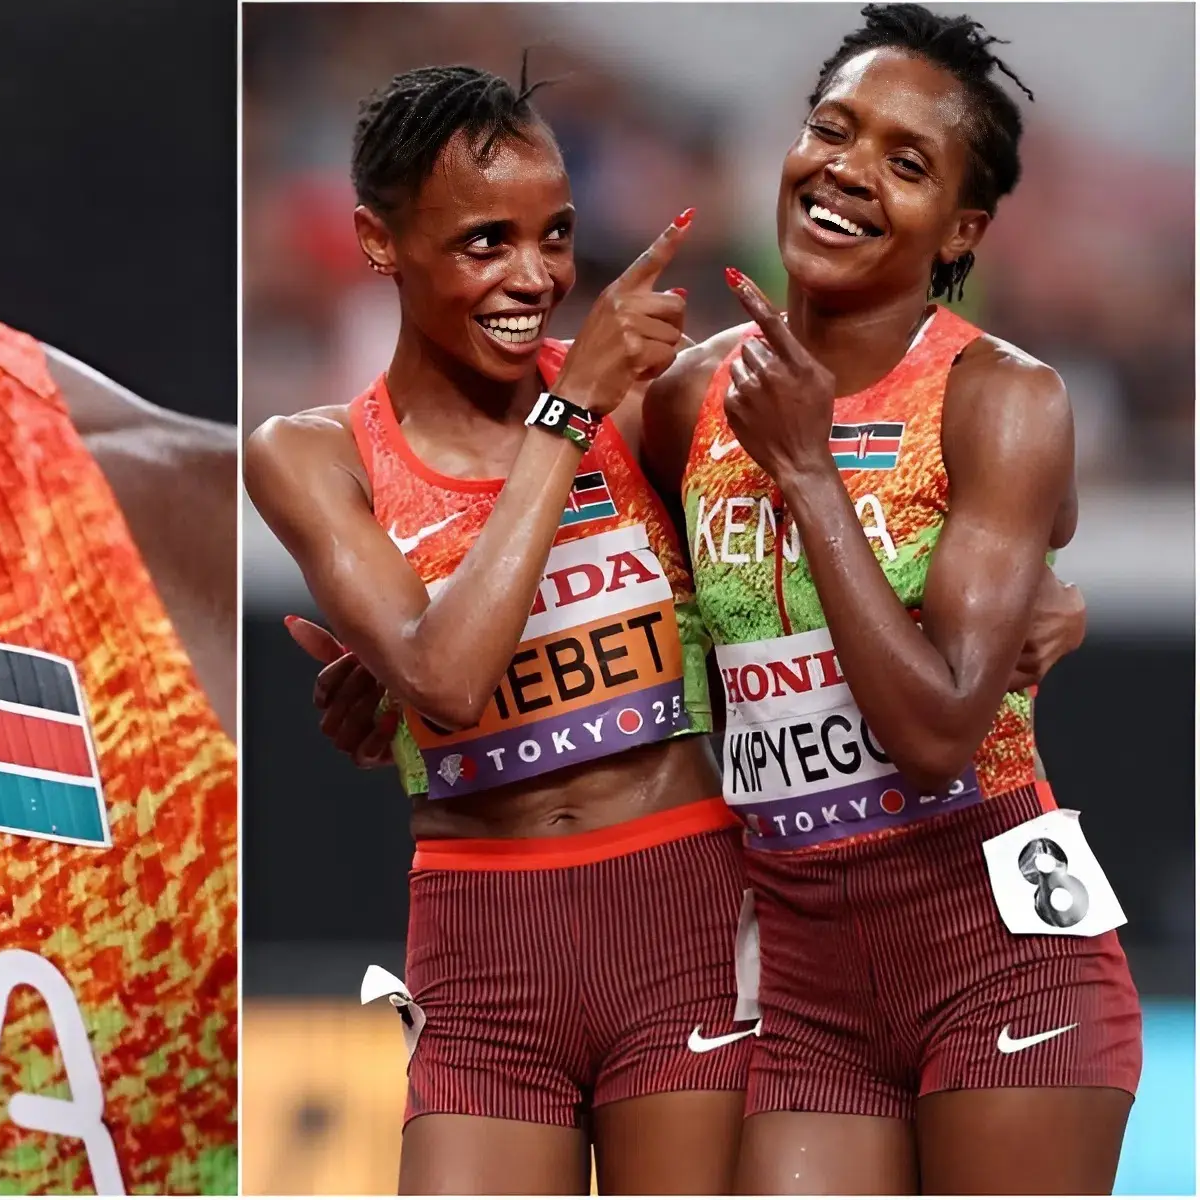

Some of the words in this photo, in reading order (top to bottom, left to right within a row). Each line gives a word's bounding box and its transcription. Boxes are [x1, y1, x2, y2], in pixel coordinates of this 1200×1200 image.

[694, 493, 898, 563] KENA
[421, 611, 664, 736] EBET
[722, 649, 844, 704] HON
[486, 707, 643, 771] TOKYO
[773, 788, 905, 838] TOKYO
[1018, 837, 1090, 928] 8
